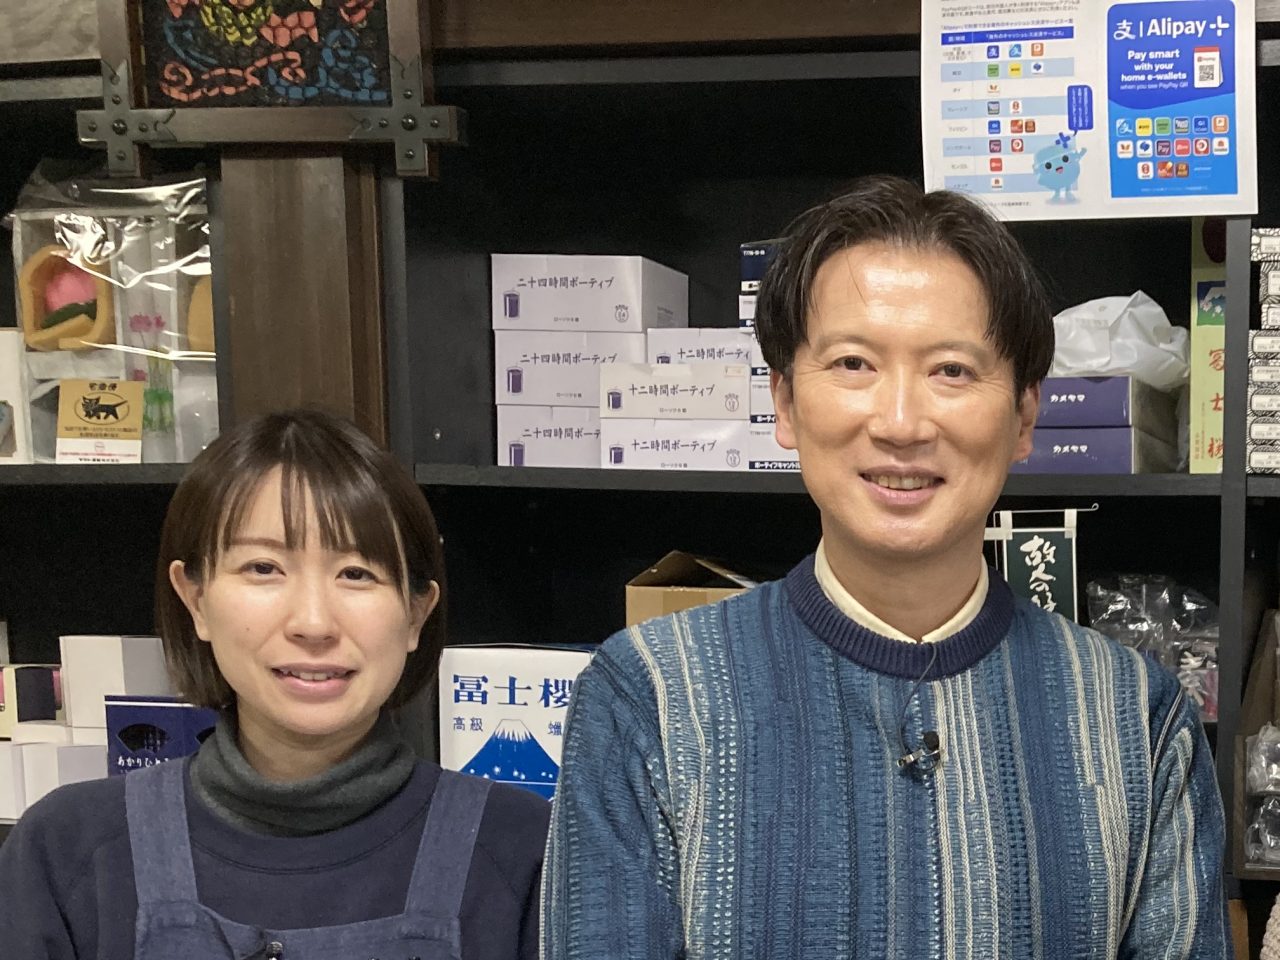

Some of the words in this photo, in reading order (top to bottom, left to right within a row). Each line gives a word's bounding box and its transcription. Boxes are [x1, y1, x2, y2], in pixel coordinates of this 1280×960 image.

[1128, 50, 1146, 61] Pay
[1149, 48, 1180, 59] smart
[1134, 62, 1153, 71] with
[1155, 62, 1174, 72] your
[1121, 74, 1145, 82] home
[1147, 72, 1187, 81] e-wallets
[517, 276, 615, 289] 二十四時間ボーティブ
[628, 384, 715, 397] 十二時間ボーティブ
[631, 439, 717, 453] 十二時間ボーティブ
[453, 716, 483, 732] 高級
